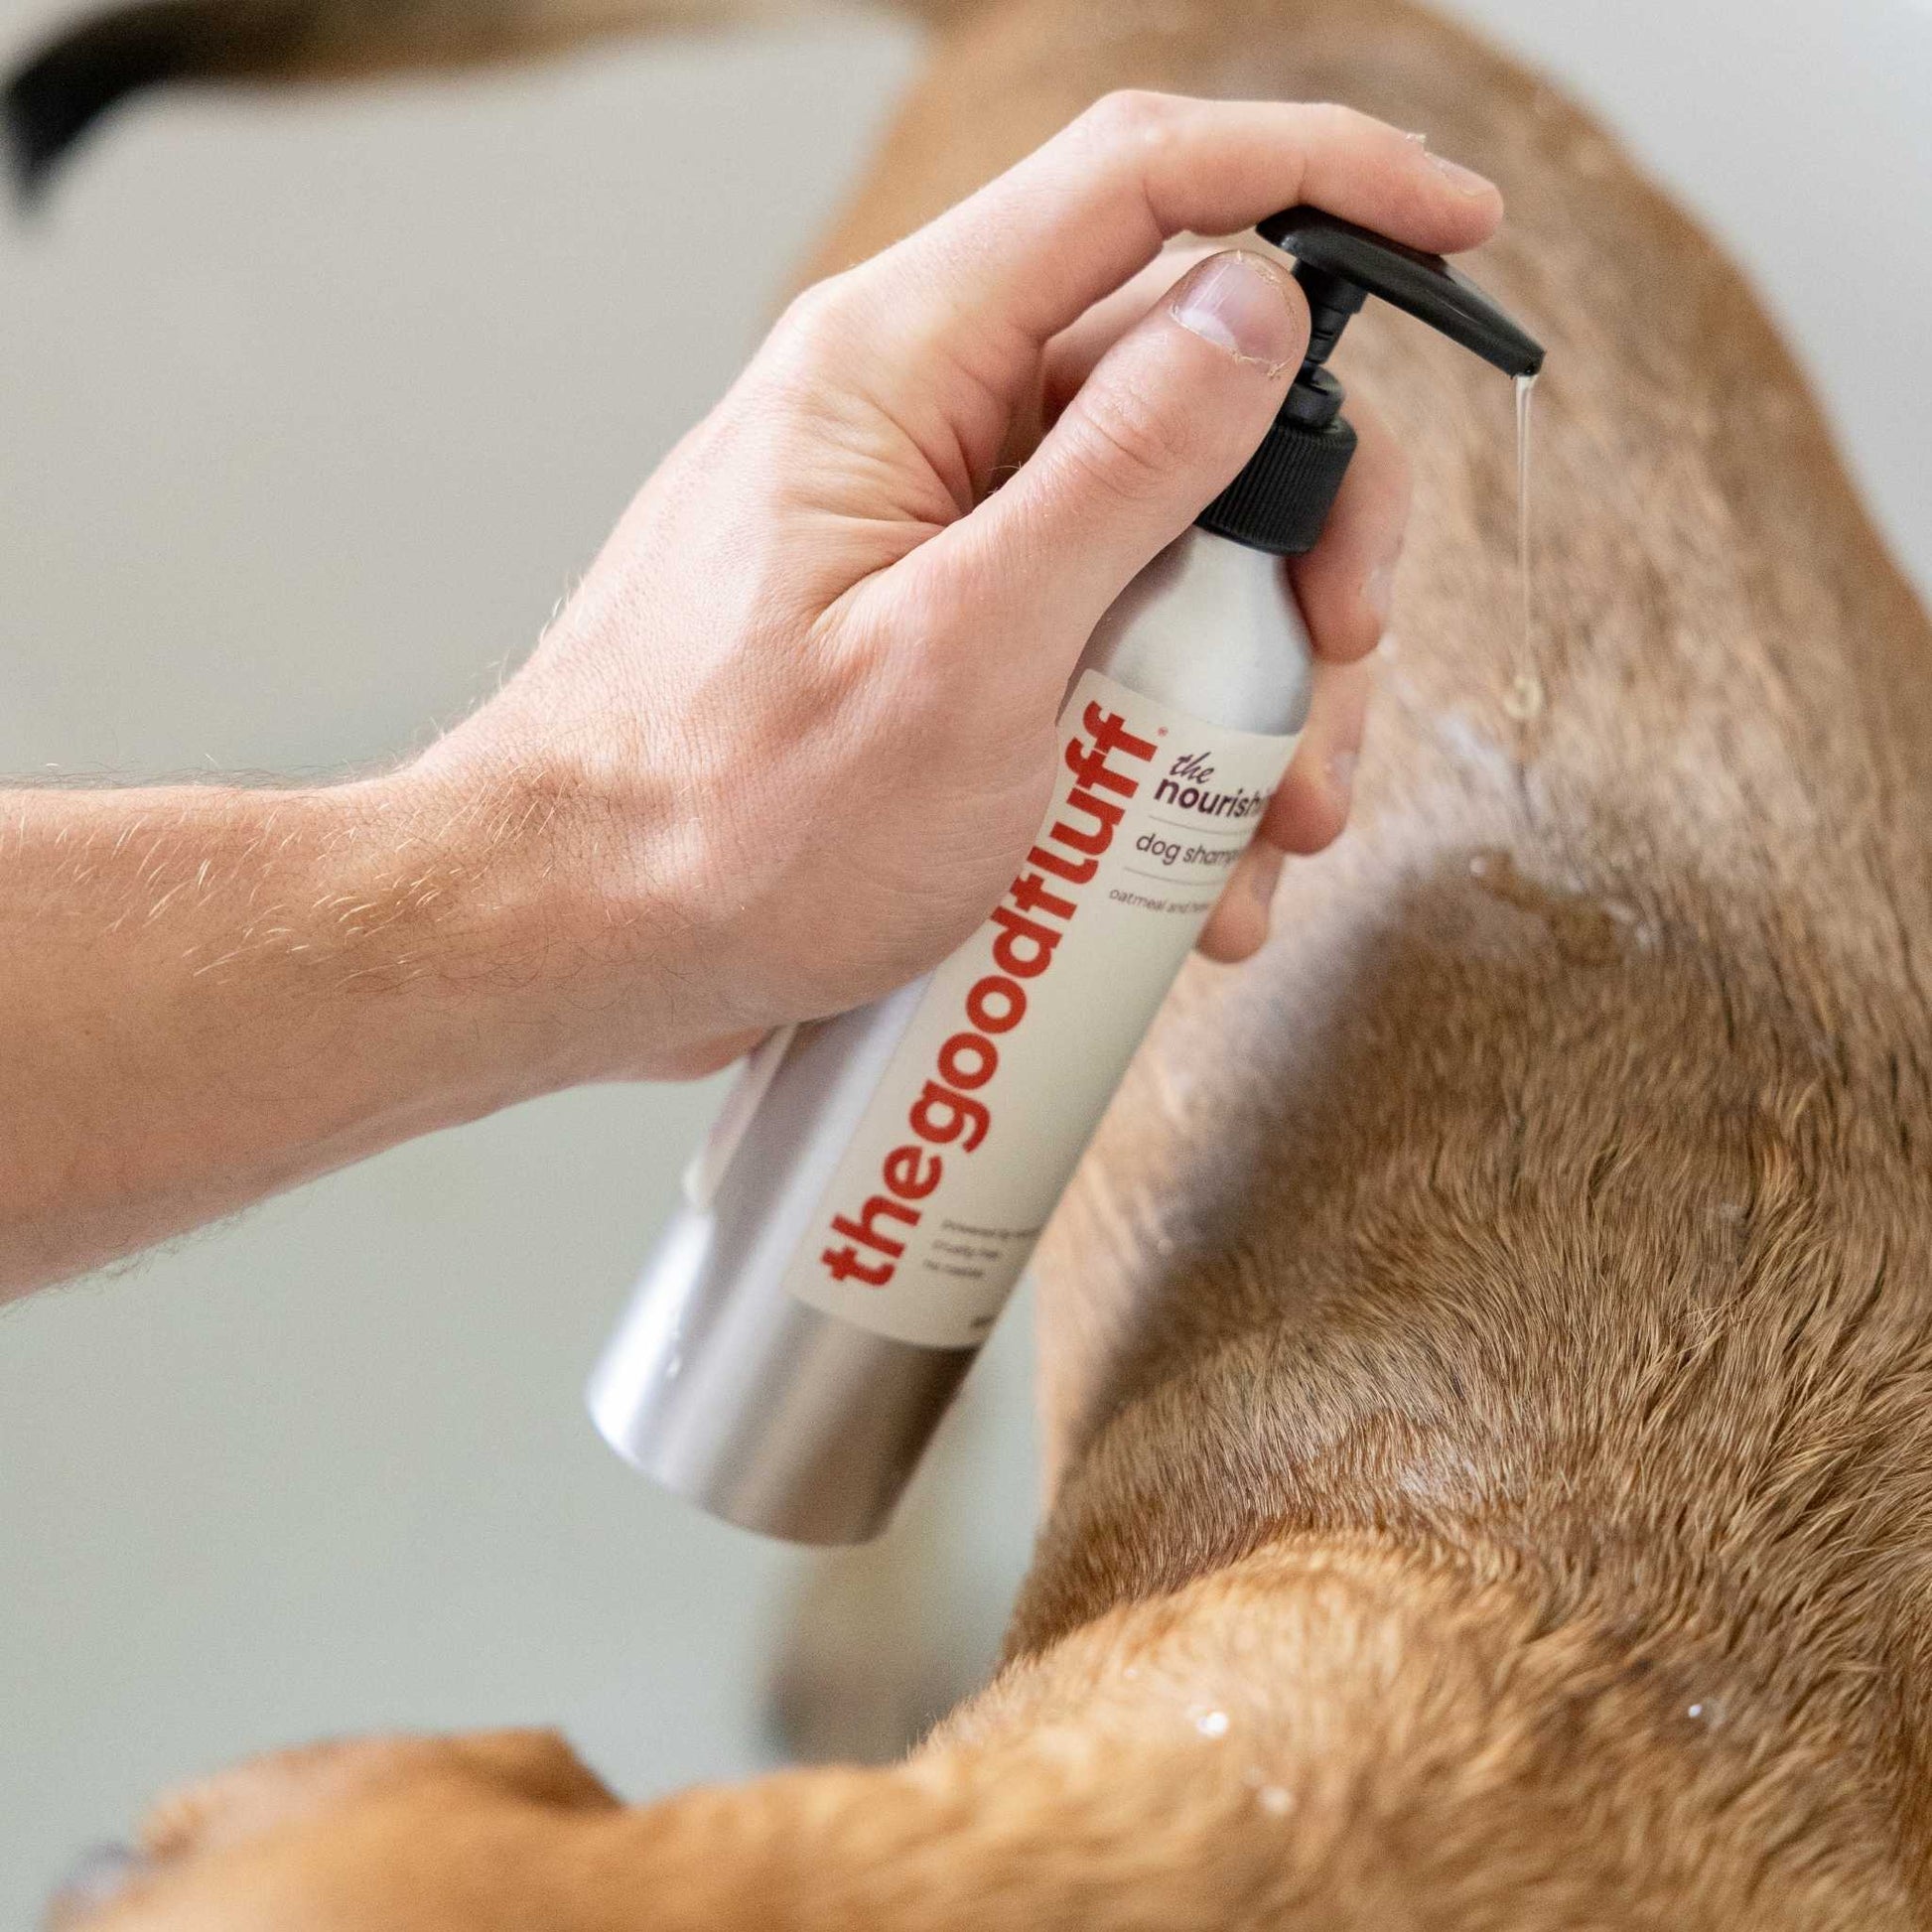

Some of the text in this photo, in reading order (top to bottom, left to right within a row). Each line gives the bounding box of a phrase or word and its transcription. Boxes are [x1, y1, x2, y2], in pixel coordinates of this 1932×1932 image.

[1169, 752, 1215, 784] the
[1153, 778, 1267, 818] nourish
[1135, 833, 1181, 866] dog
[1109, 889, 1167, 911] oatmeal
[820, 700, 1159, 1287] thegoodfluff
